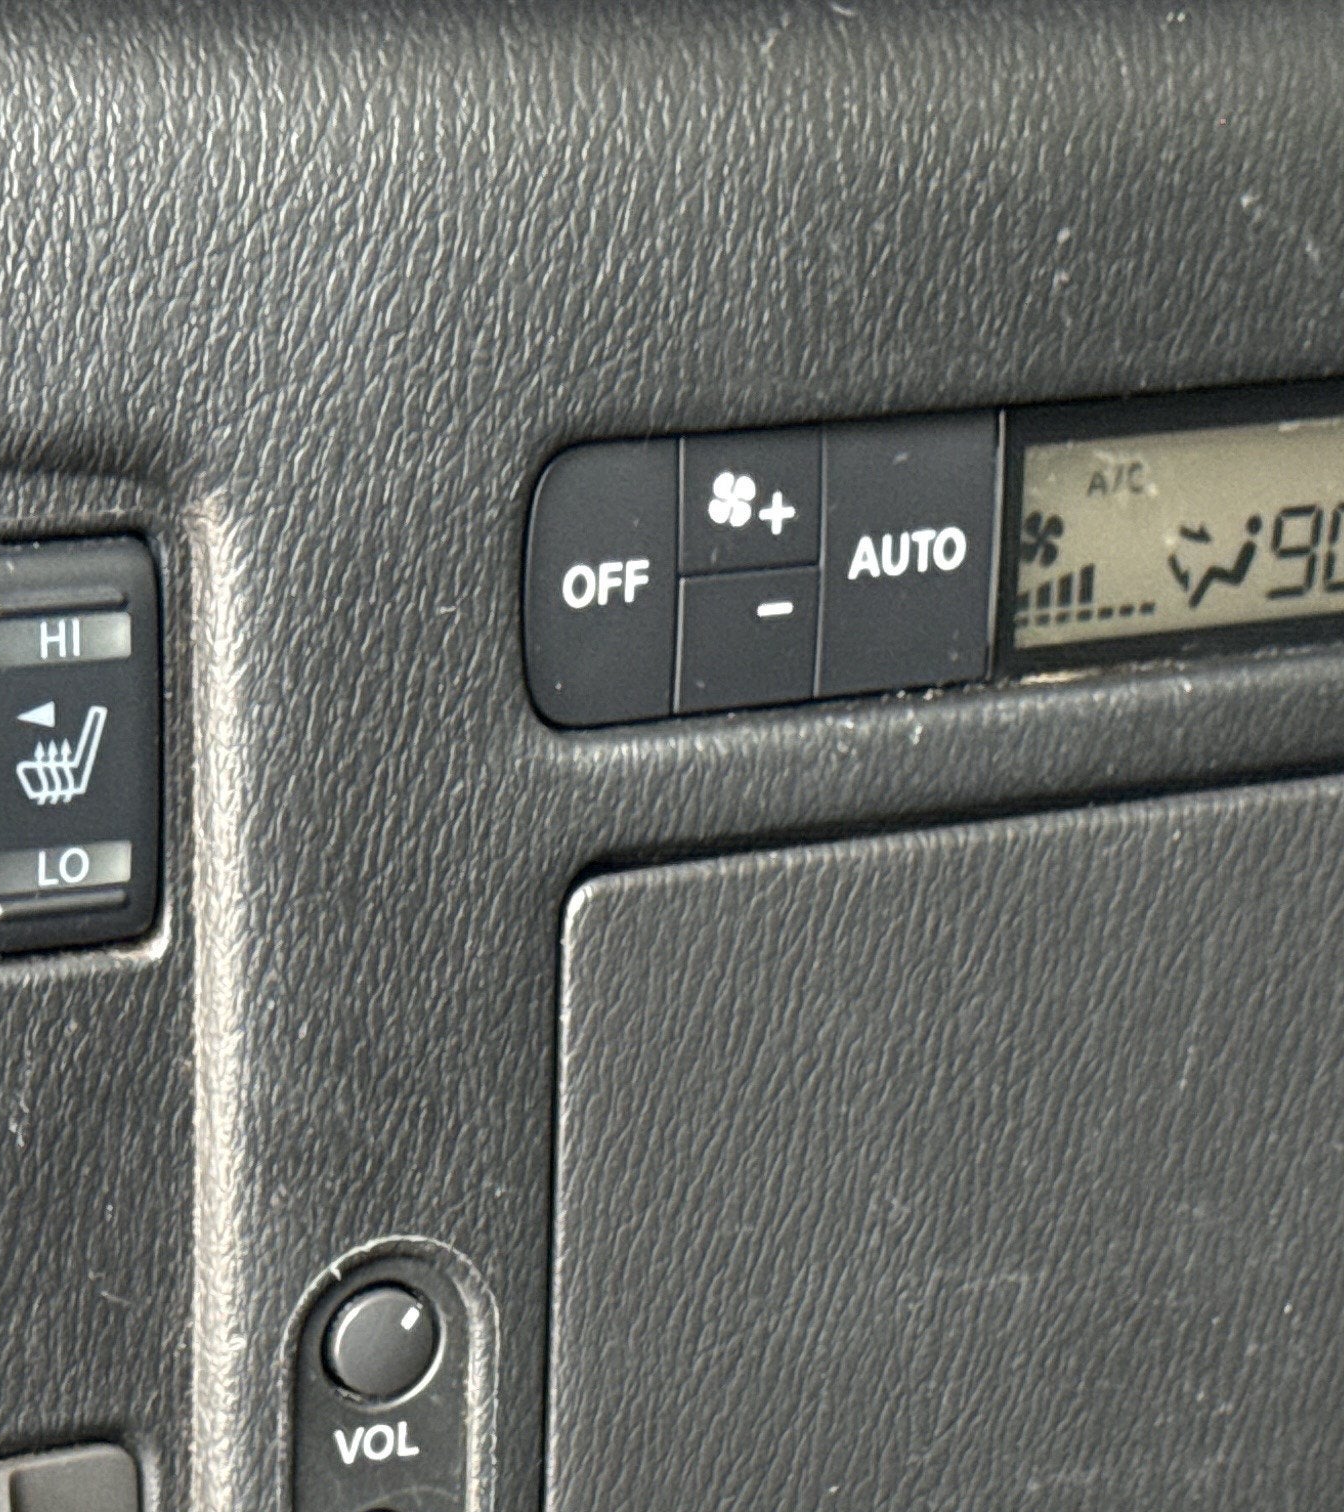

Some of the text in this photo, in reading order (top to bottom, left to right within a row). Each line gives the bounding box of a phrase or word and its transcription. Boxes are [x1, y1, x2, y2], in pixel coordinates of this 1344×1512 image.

[1086, 461, 1145, 497] A/C
[847, 526, 967, 580] AUTO
[562, 558, 650, 609] OFF
[40, 617, 81, 660] HI
[37, 847, 90, 886] LO
[334, 1421, 419, 1465] VOL
